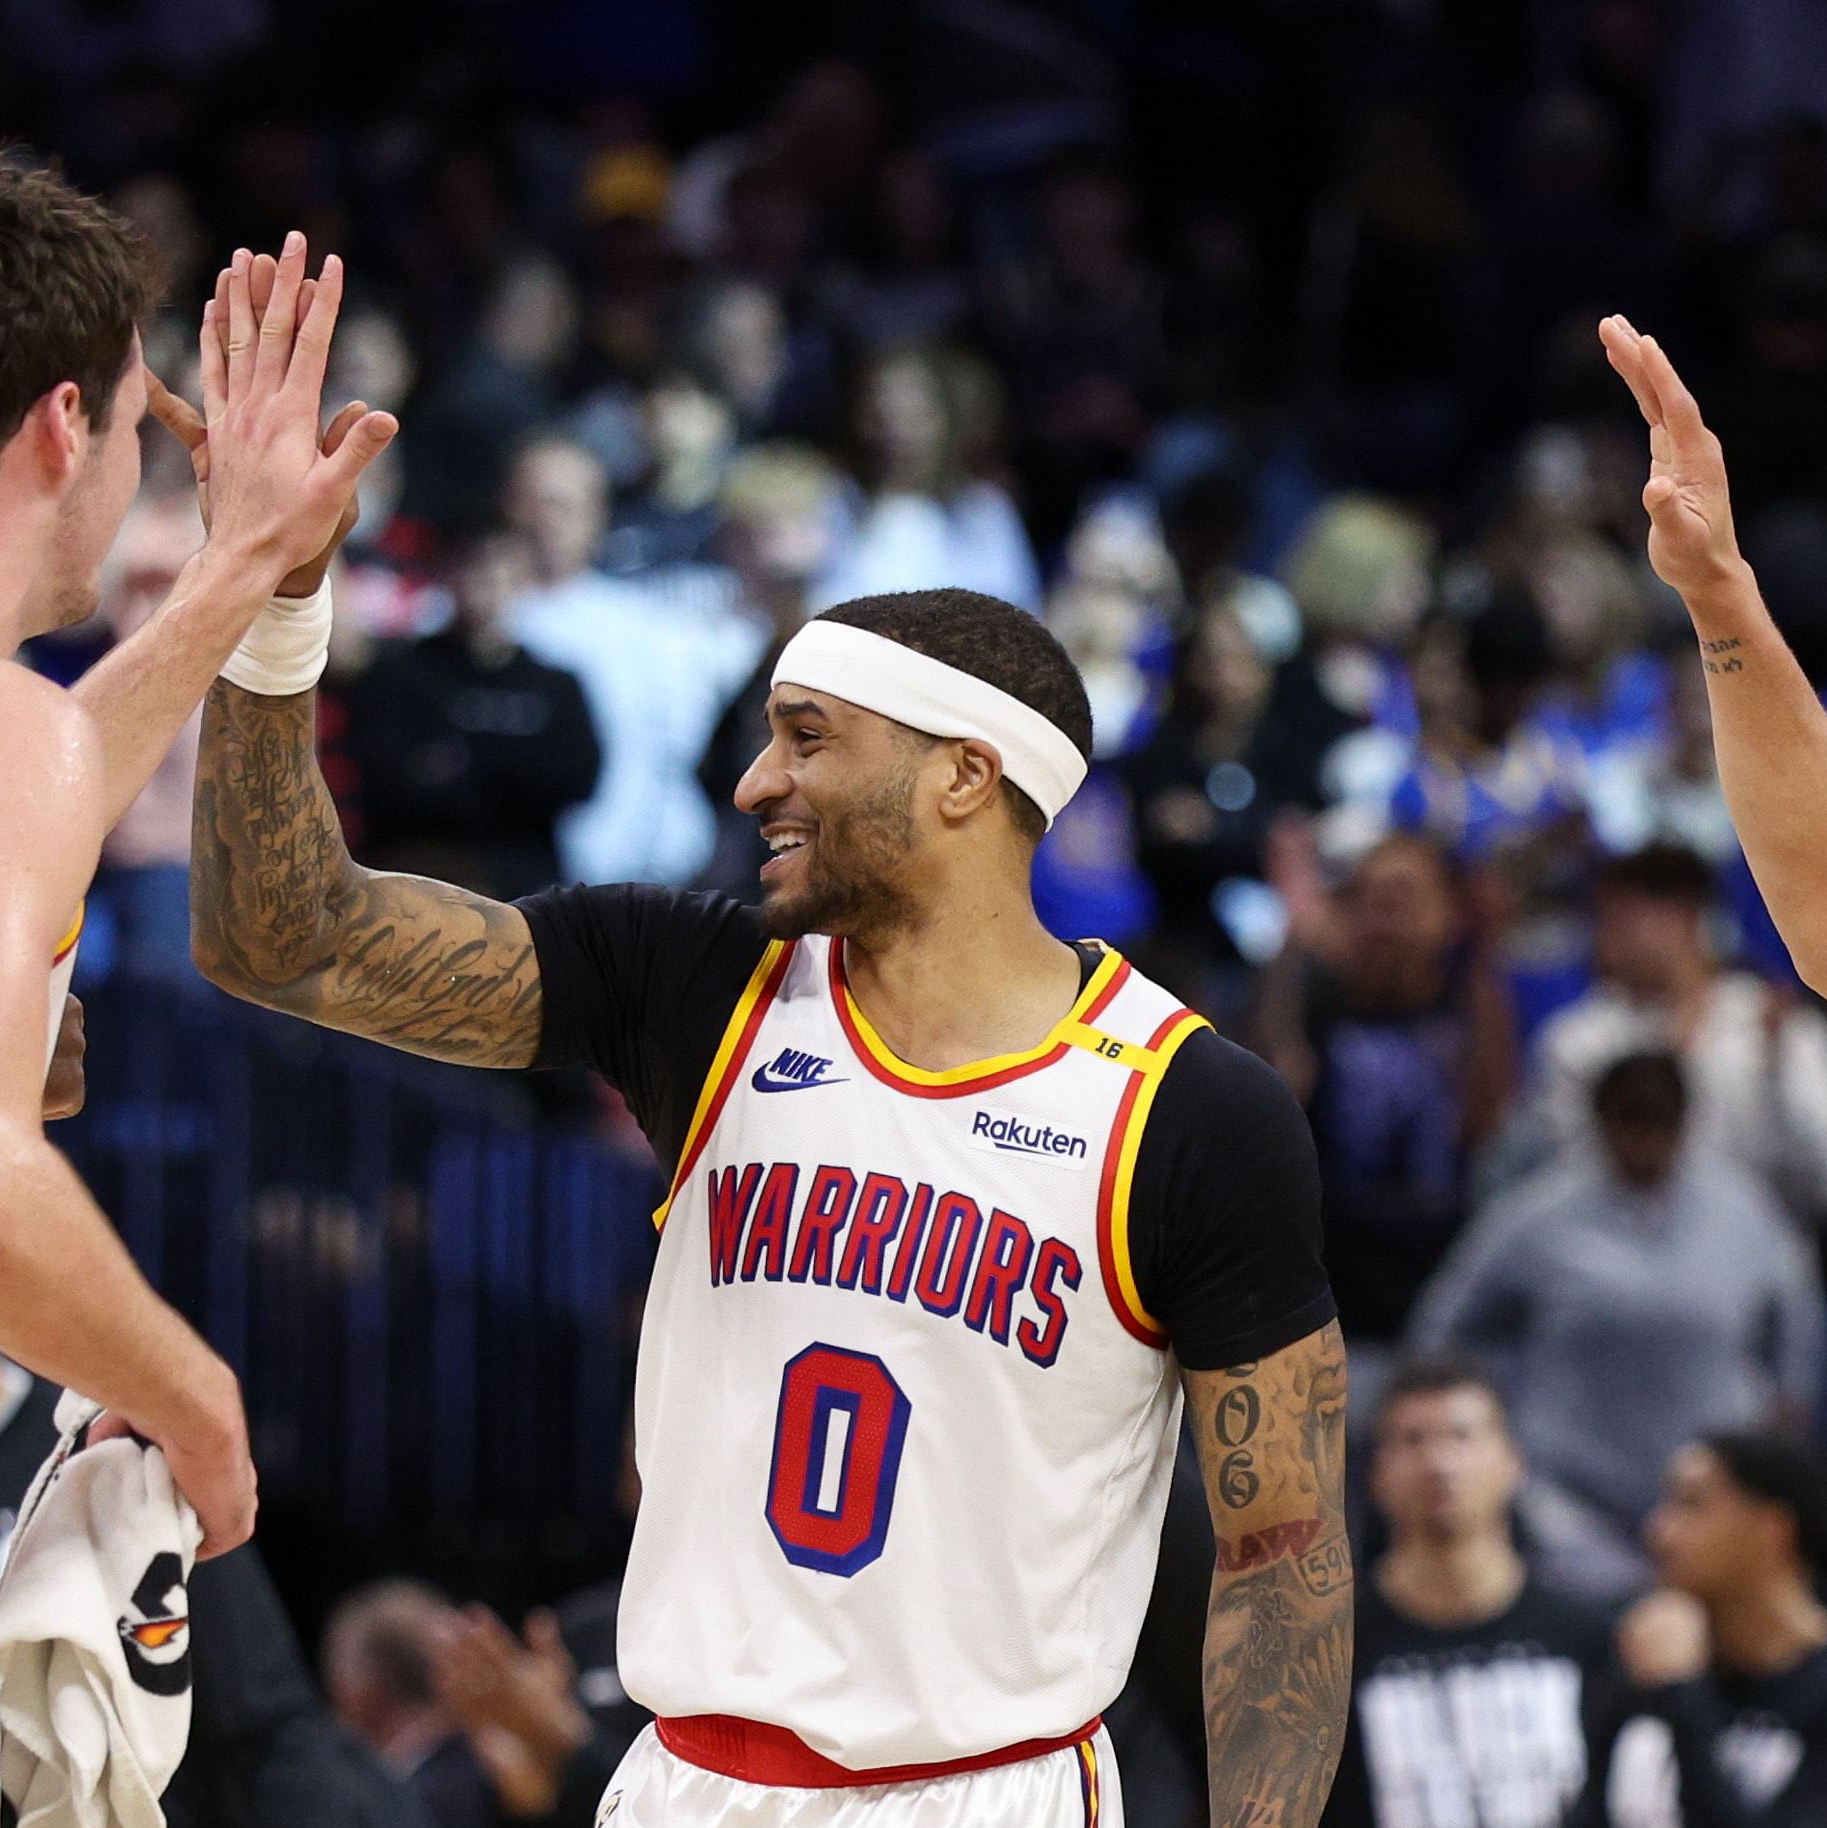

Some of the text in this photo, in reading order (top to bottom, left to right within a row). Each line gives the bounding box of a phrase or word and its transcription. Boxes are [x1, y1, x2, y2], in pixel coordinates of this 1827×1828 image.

[770, 1046, 834, 1083] NIKE
[1095, 1037, 1124, 1059] 16
[972, 1110, 1087, 1159] Rakuten
[708, 1162, 1082, 1369] WARRIORS
[764, 1341, 912, 1579] 0
[1215, 1361, 1261, 1509] 06
